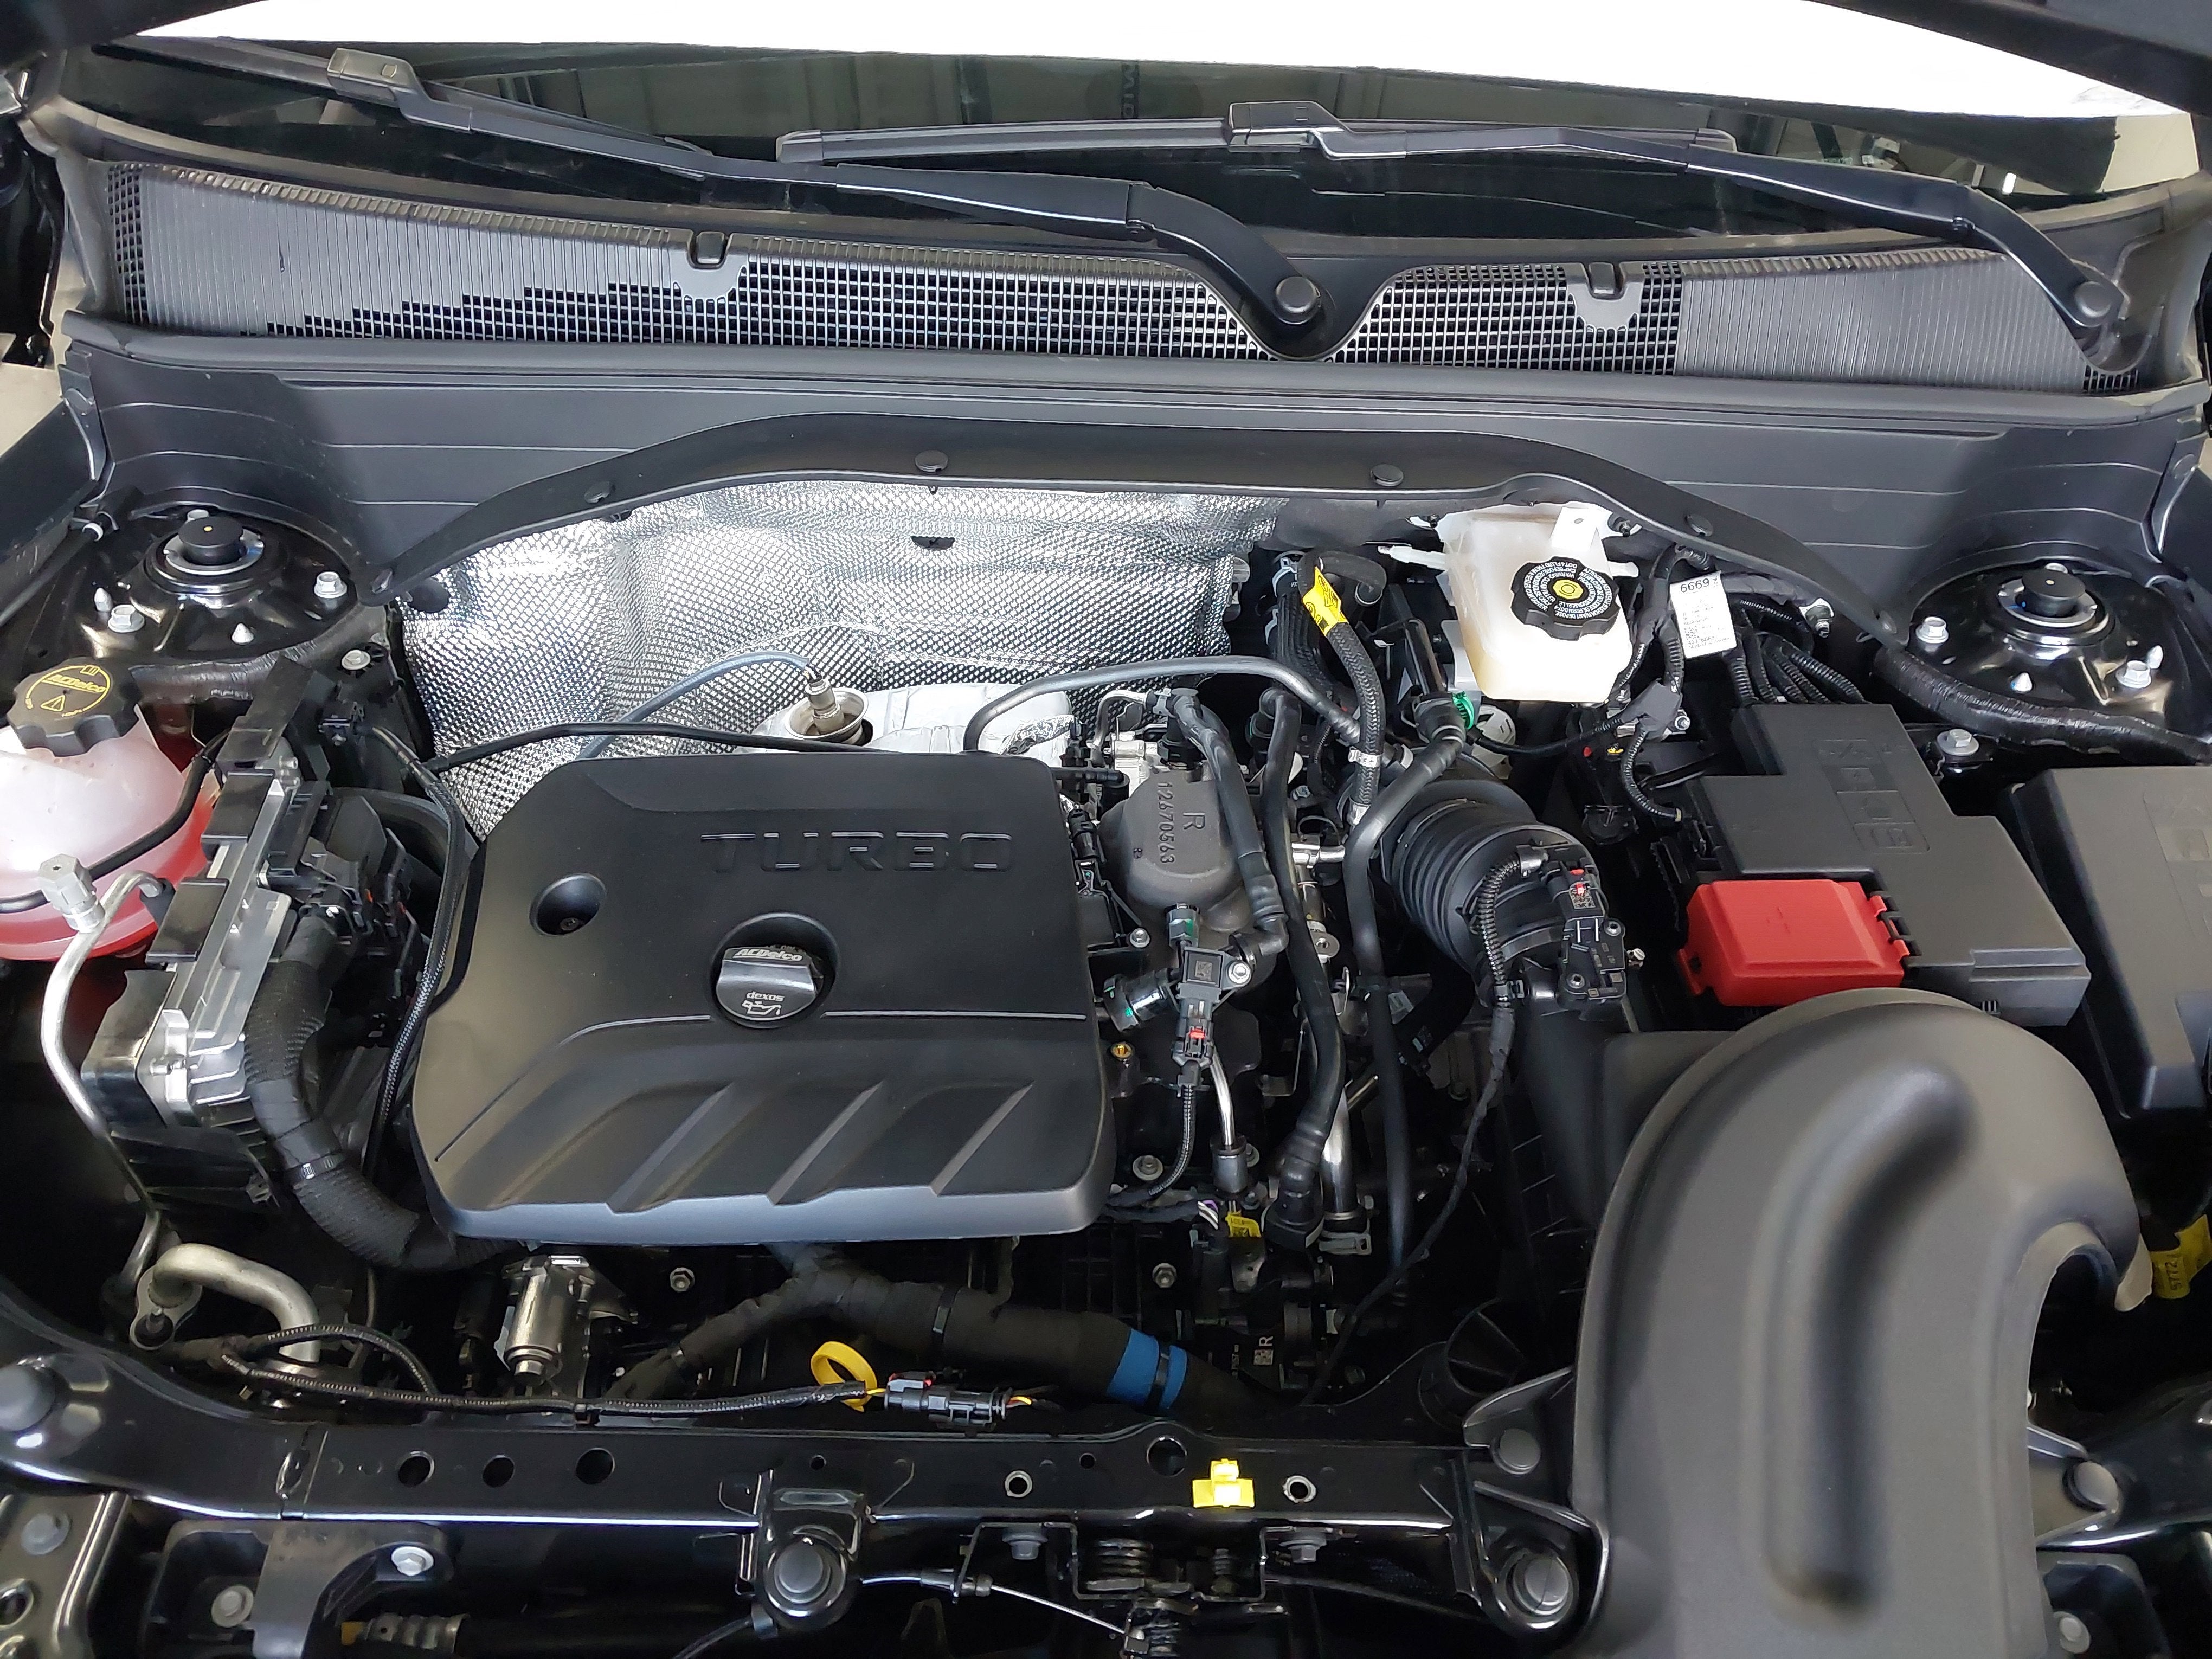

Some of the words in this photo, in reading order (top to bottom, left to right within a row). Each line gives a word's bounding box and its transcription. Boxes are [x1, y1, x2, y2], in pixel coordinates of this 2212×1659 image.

[1680, 578, 1709, 593] 6669
[1157, 781, 1175, 864] 12670563
[1182, 811, 1206, 831] R
[700, 832, 1013, 872] TURBO
[732, 948, 803, 961] ACDelco
[746, 991, 785, 1002] dexos
[1259, 1336, 1274, 1346] R
